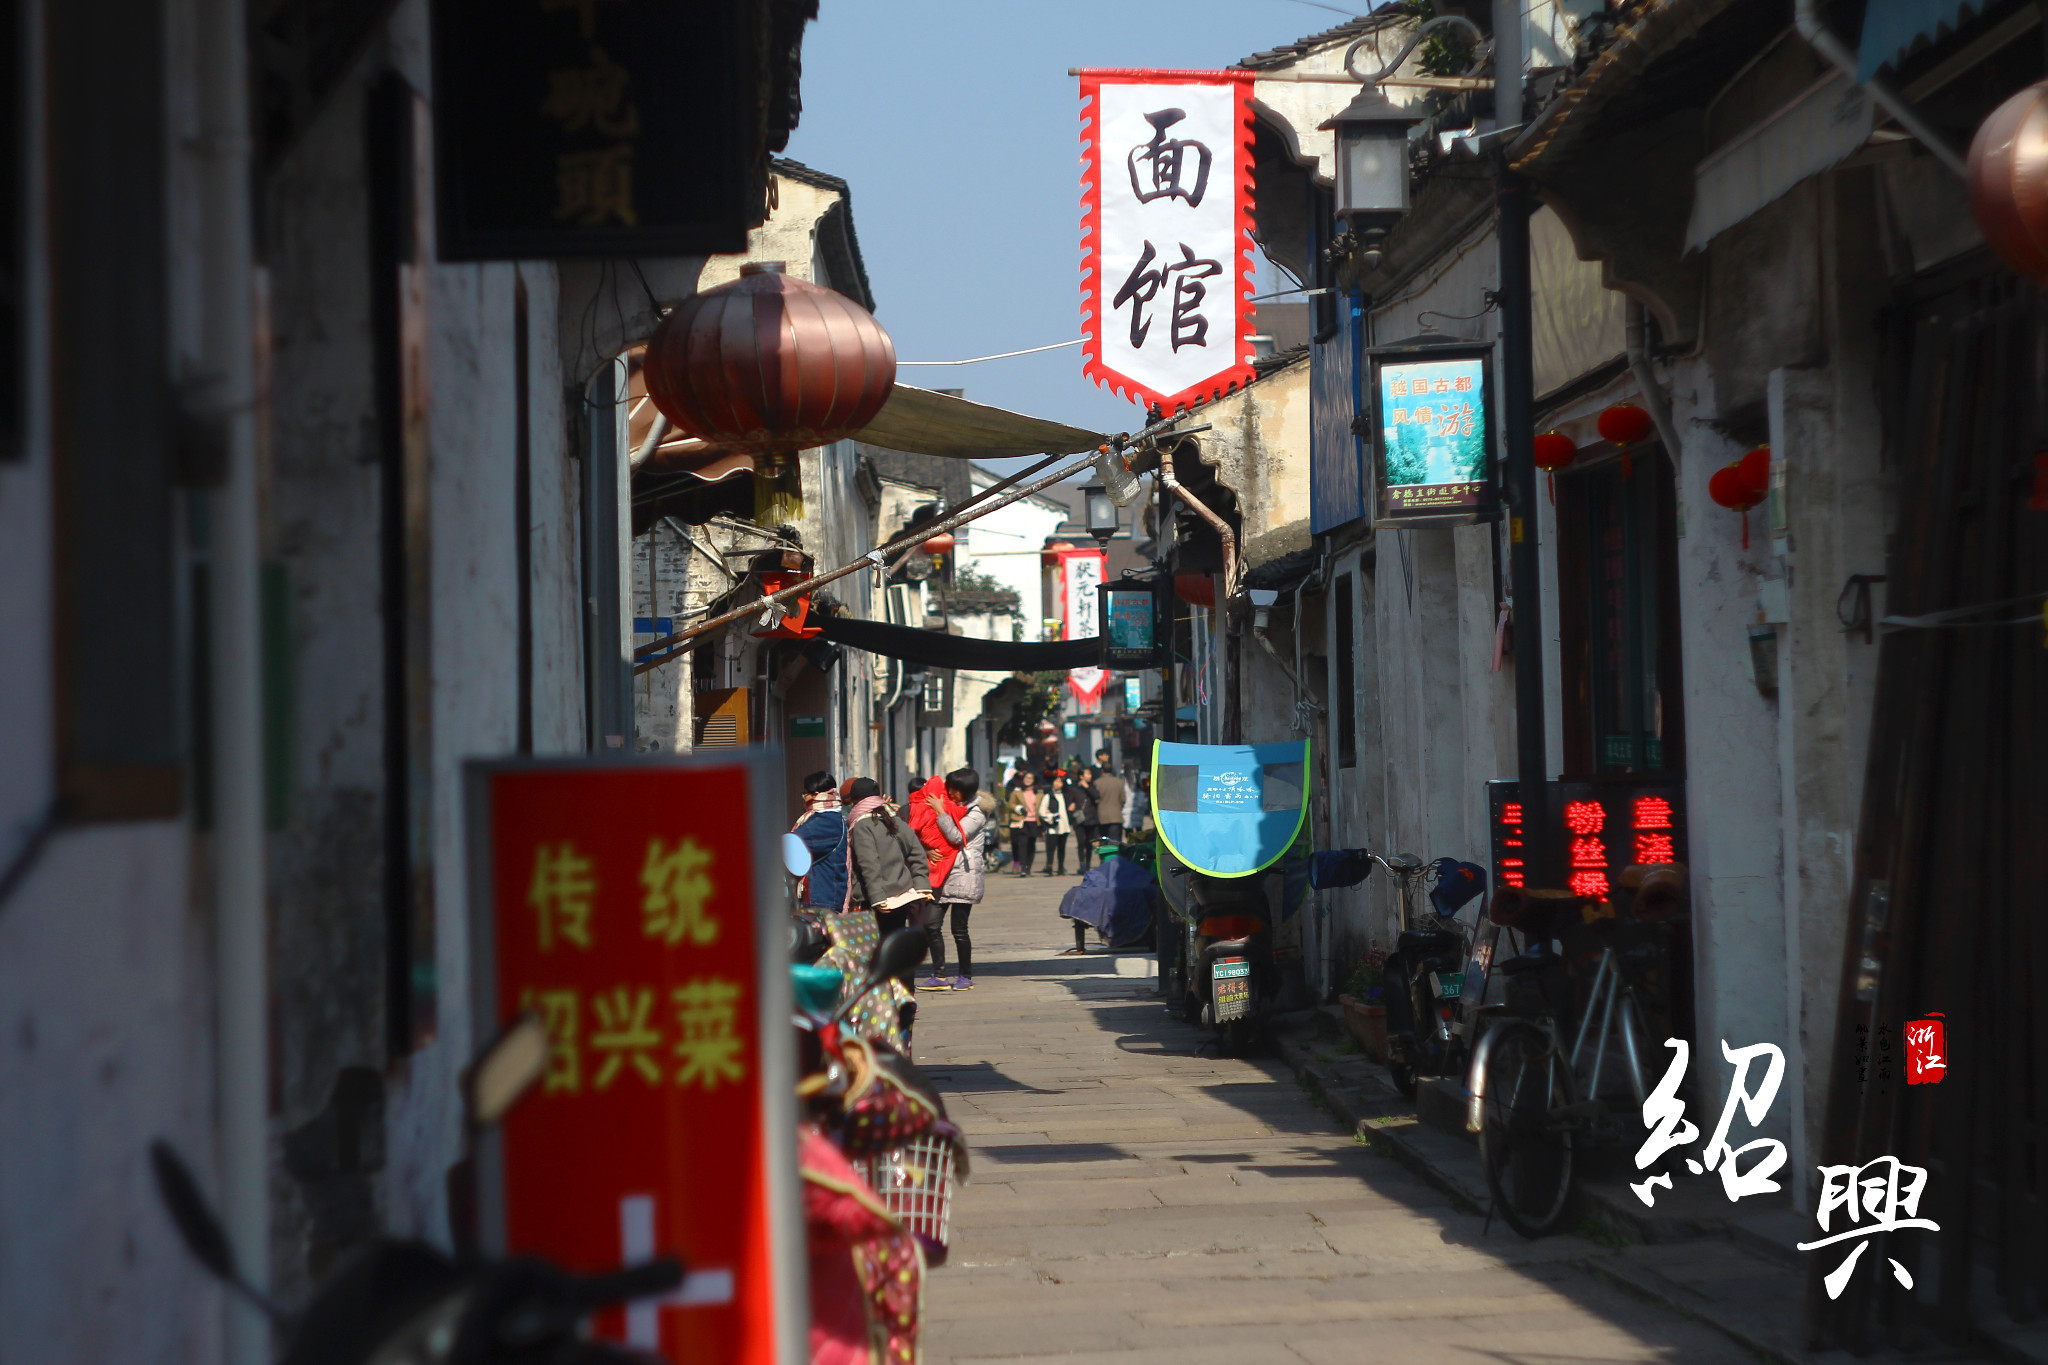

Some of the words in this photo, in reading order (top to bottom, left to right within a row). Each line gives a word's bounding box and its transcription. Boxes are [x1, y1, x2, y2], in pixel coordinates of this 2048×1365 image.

[1113, 107, 1224, 355] 面馆
[1390, 376, 1473, 397] 越国古都
[1392, 402, 1476, 437] 风情游
[530, 836, 720, 950] 传统
[519, 981, 745, 1093] 绍兴菜
